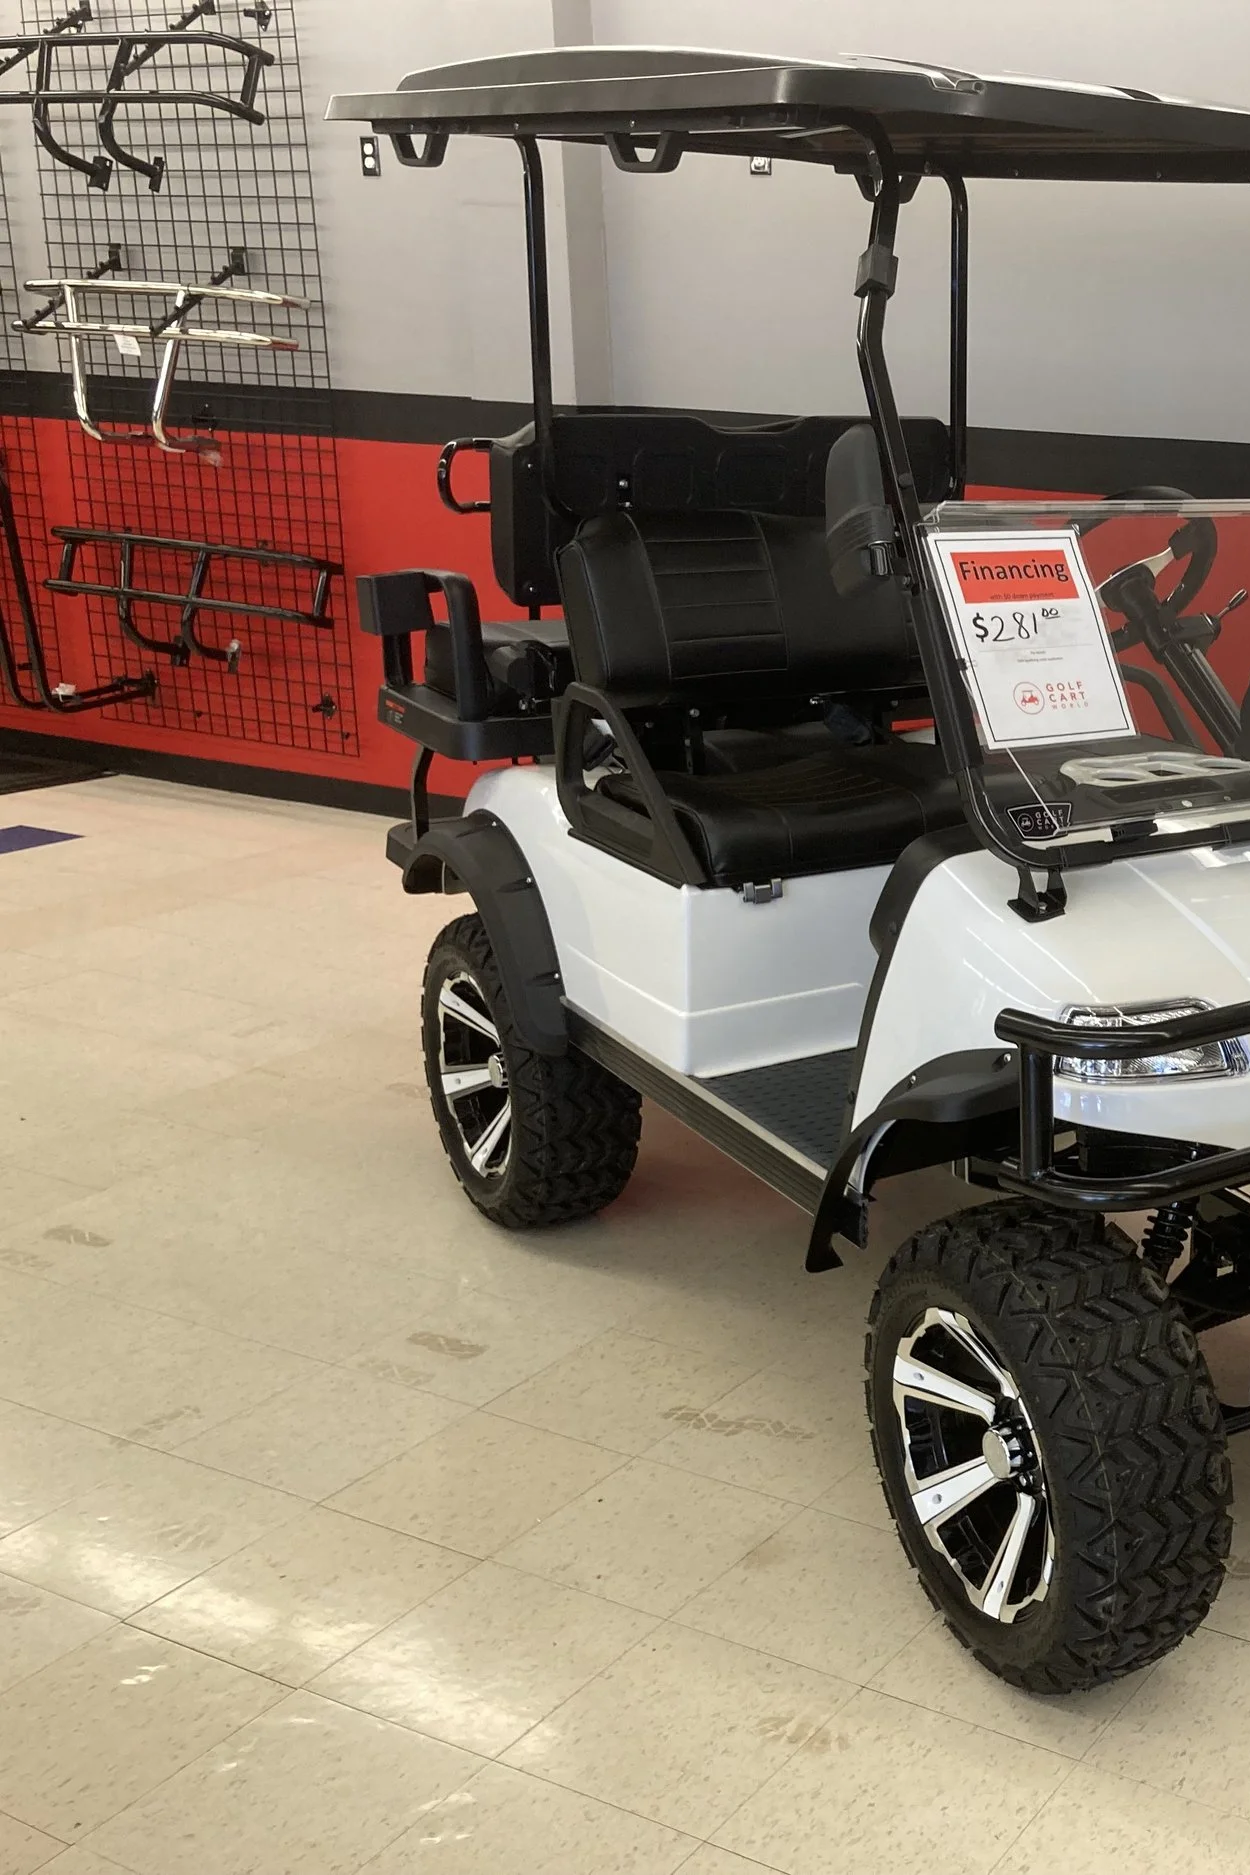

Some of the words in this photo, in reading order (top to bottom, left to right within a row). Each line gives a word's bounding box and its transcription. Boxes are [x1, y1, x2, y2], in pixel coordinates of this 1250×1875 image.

[958, 559, 1069, 583] Financing
[1045, 681, 1083, 693] GOLF
[1048, 691, 1086, 703] CART
